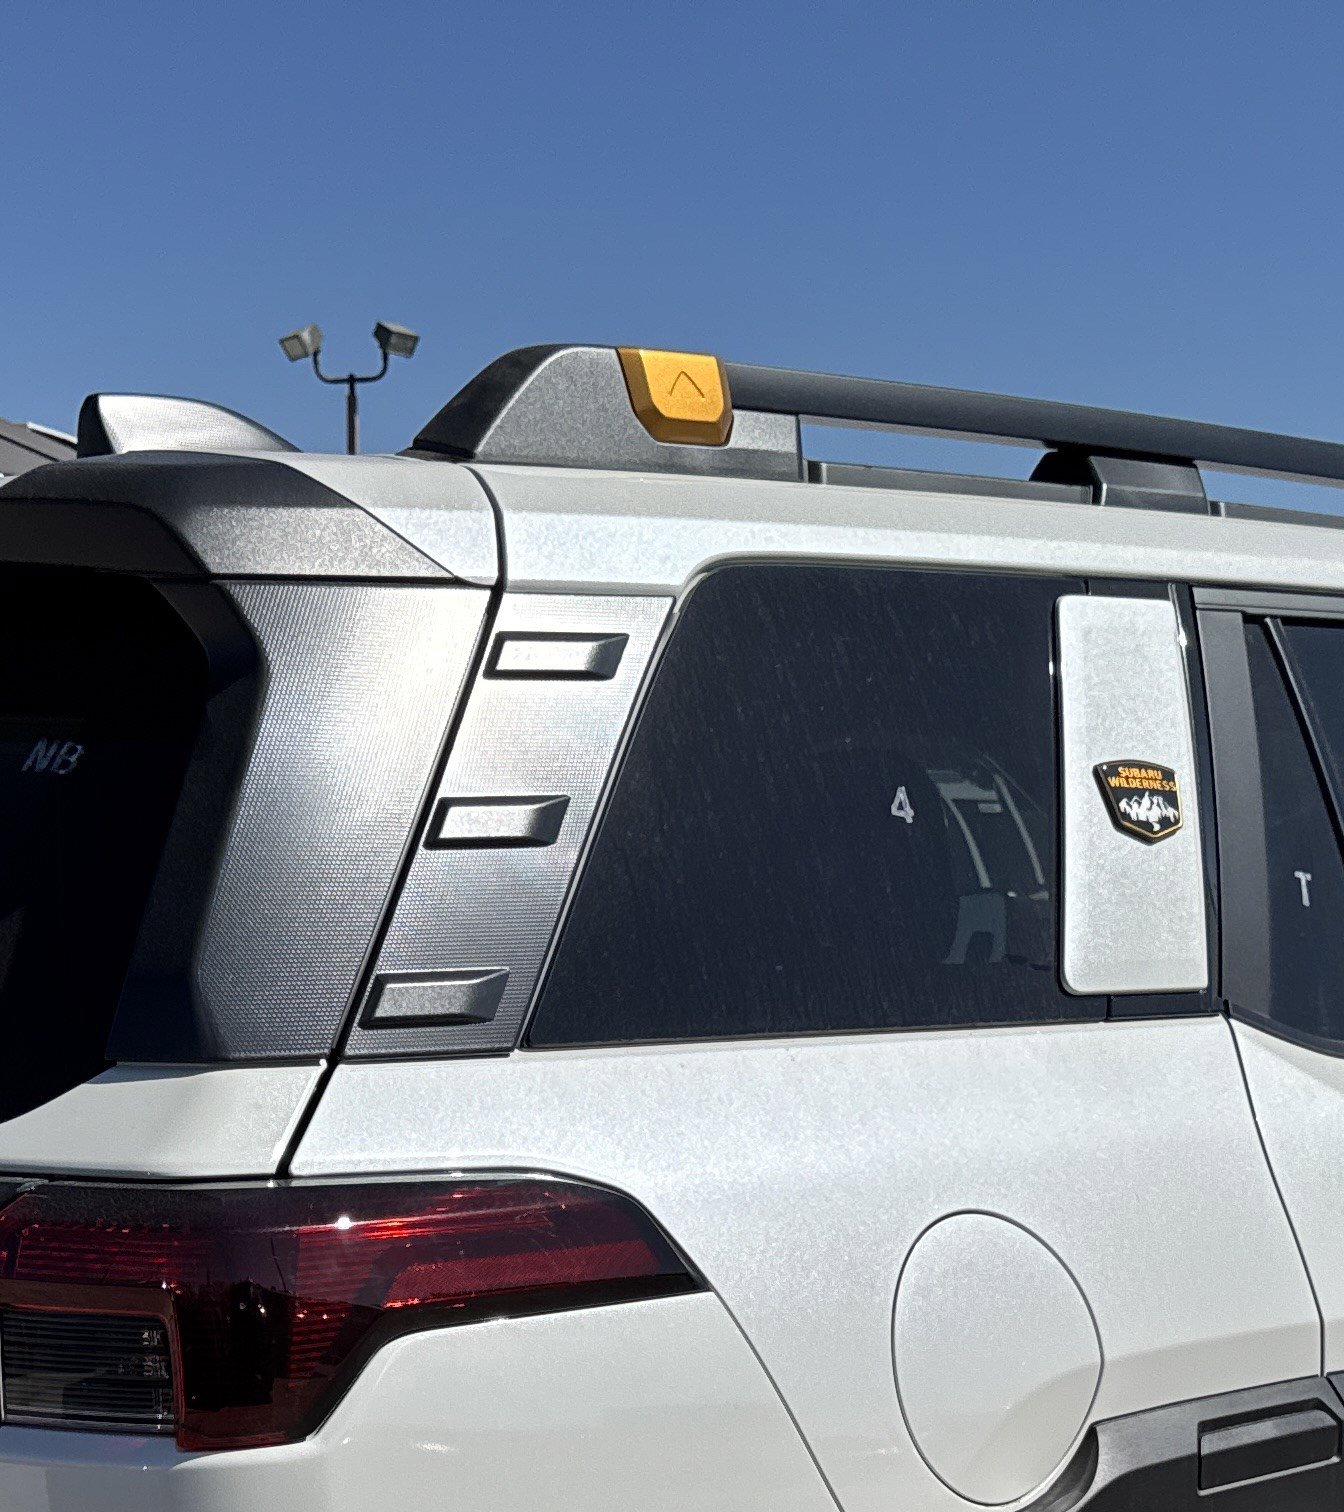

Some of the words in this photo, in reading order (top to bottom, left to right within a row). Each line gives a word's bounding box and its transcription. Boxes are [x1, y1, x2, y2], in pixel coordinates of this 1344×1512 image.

[1108, 776, 1177, 791] WILDERNESS
[1117, 766, 1163, 779] SUBARU
[891, 786, 914, 824] 4
[1294, 871, 1312, 907] T
